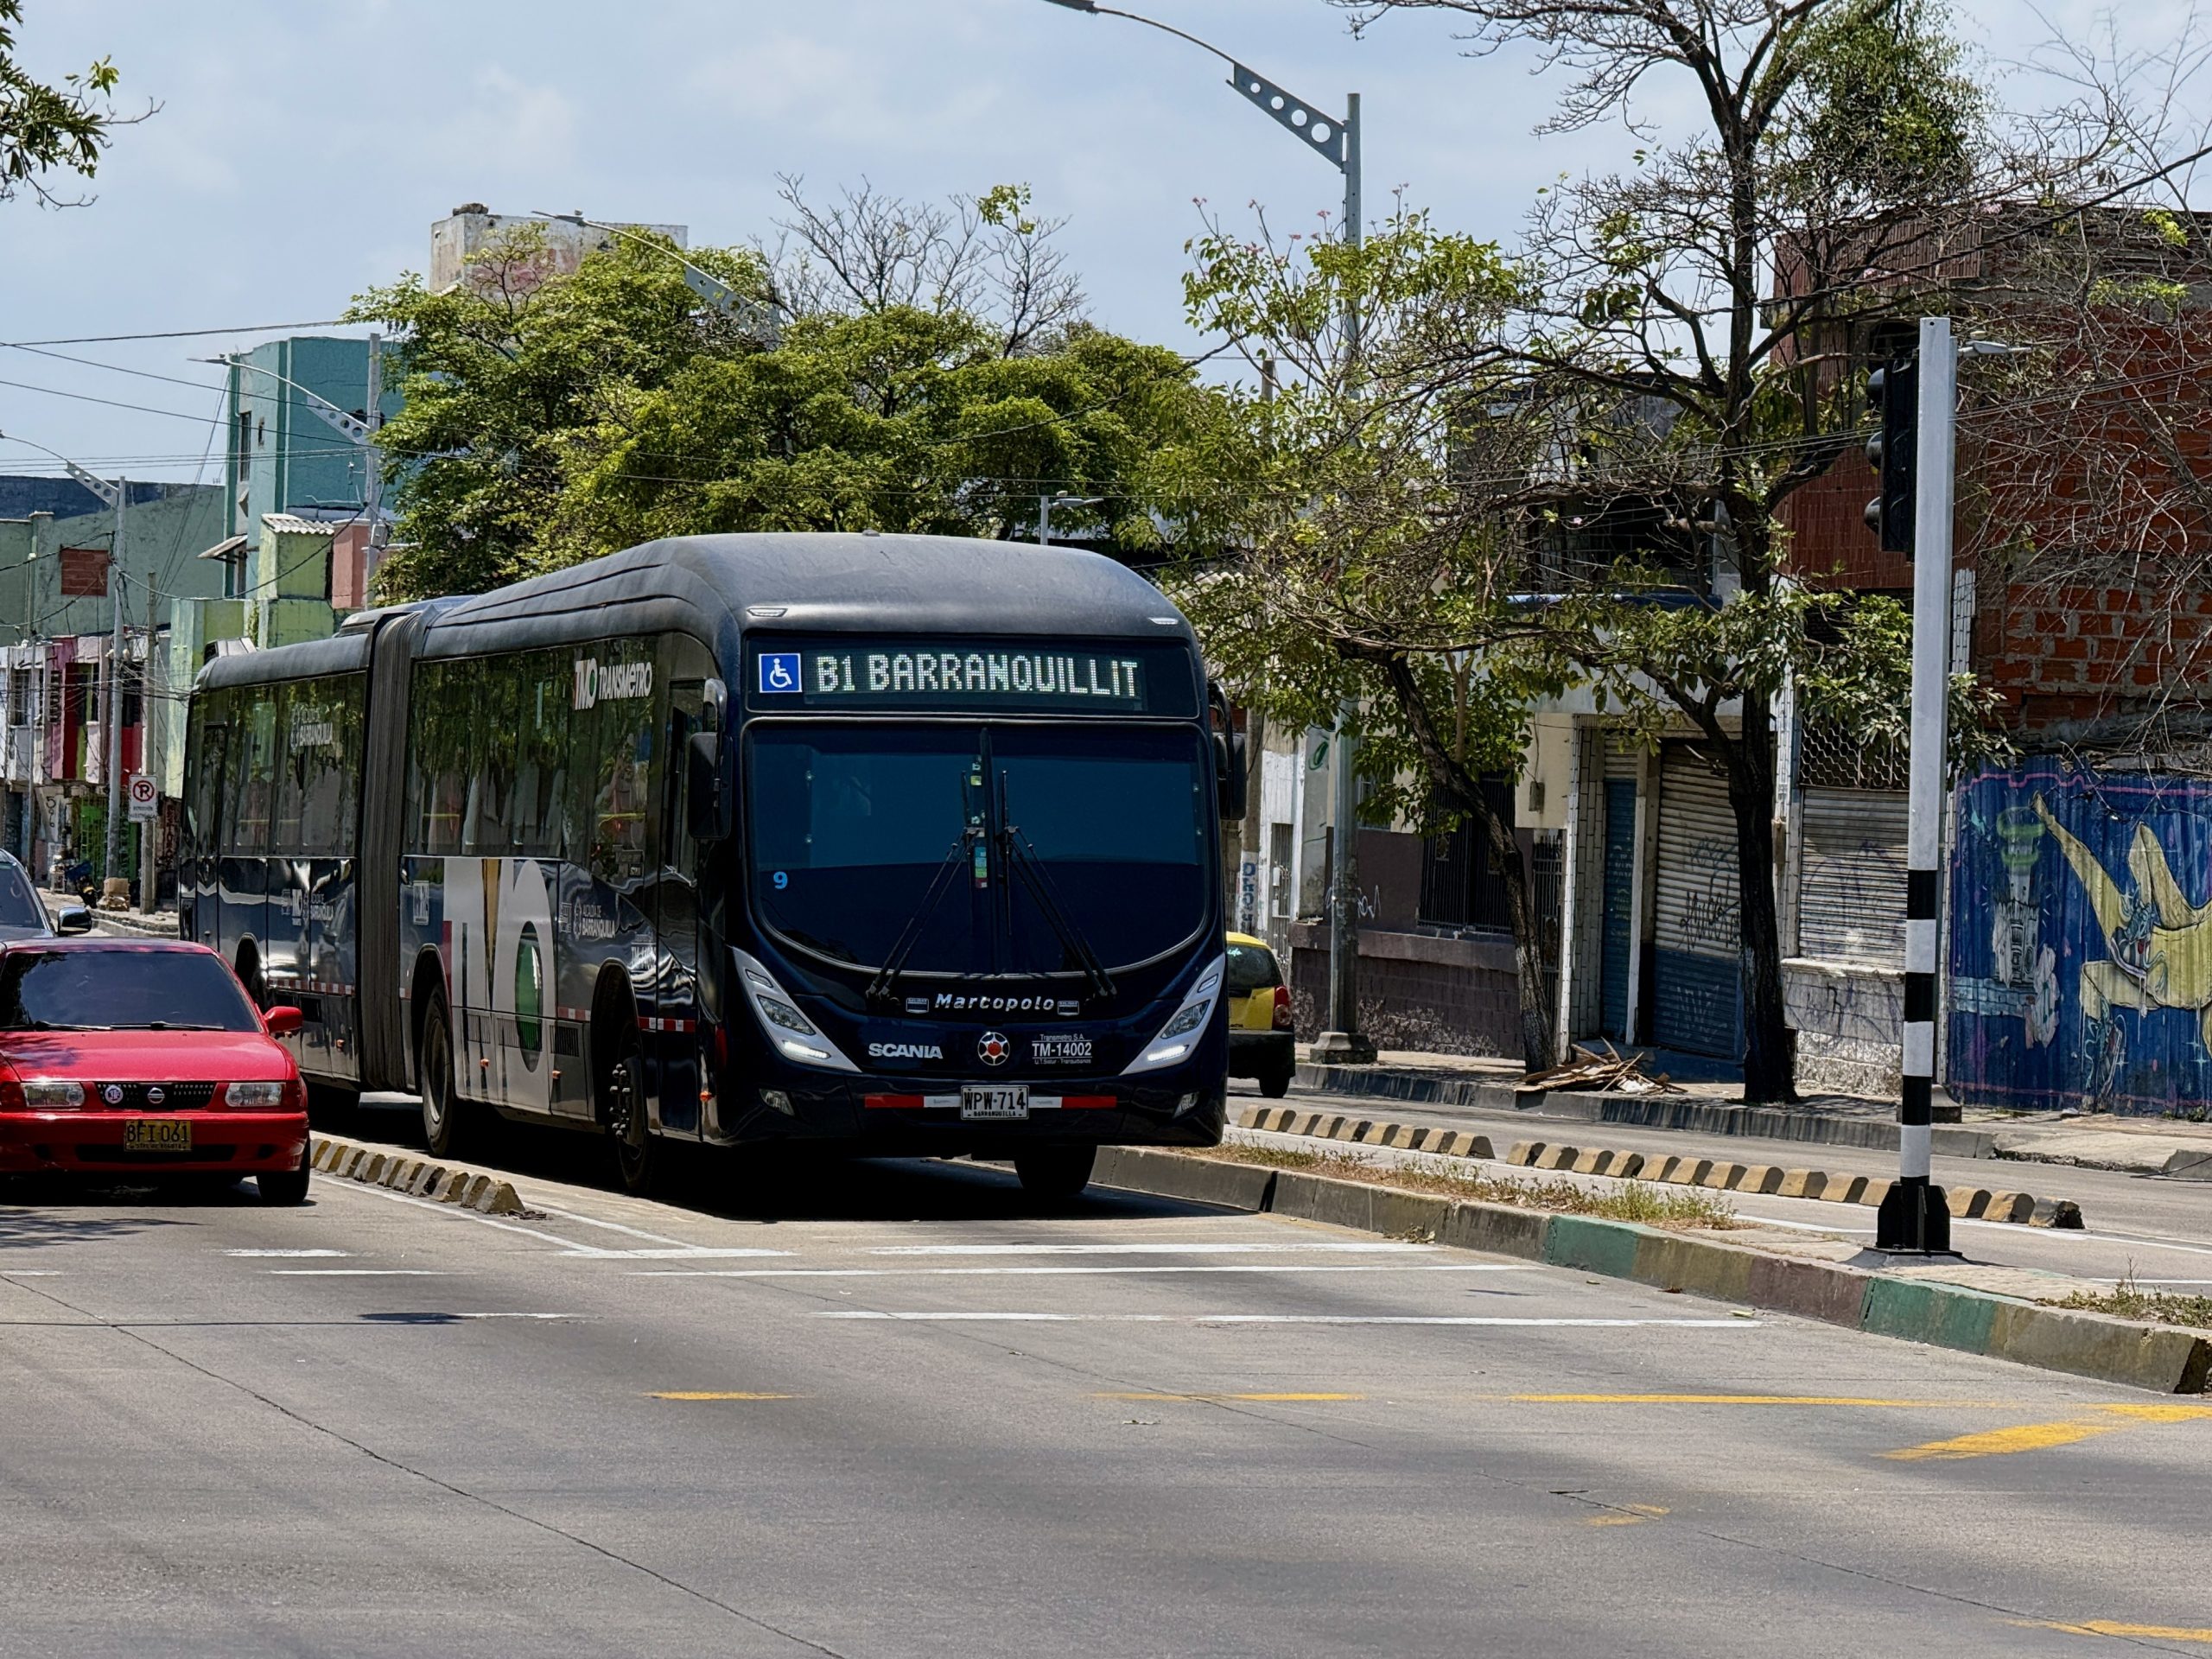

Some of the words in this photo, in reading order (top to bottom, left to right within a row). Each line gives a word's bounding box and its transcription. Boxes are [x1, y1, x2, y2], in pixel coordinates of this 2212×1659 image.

[817, 656, 855, 691] B1
[868, 654, 1138, 696] BARRANQUILLIT
[773, 871, 788, 889] 9
[582, 918, 615, 938] BARRANQUILLA
[935, 994, 1055, 1012] Marcopolo
[868, 1043, 944, 1059] SCANIA
[1032, 1042, 1092, 1057] TM-14002
